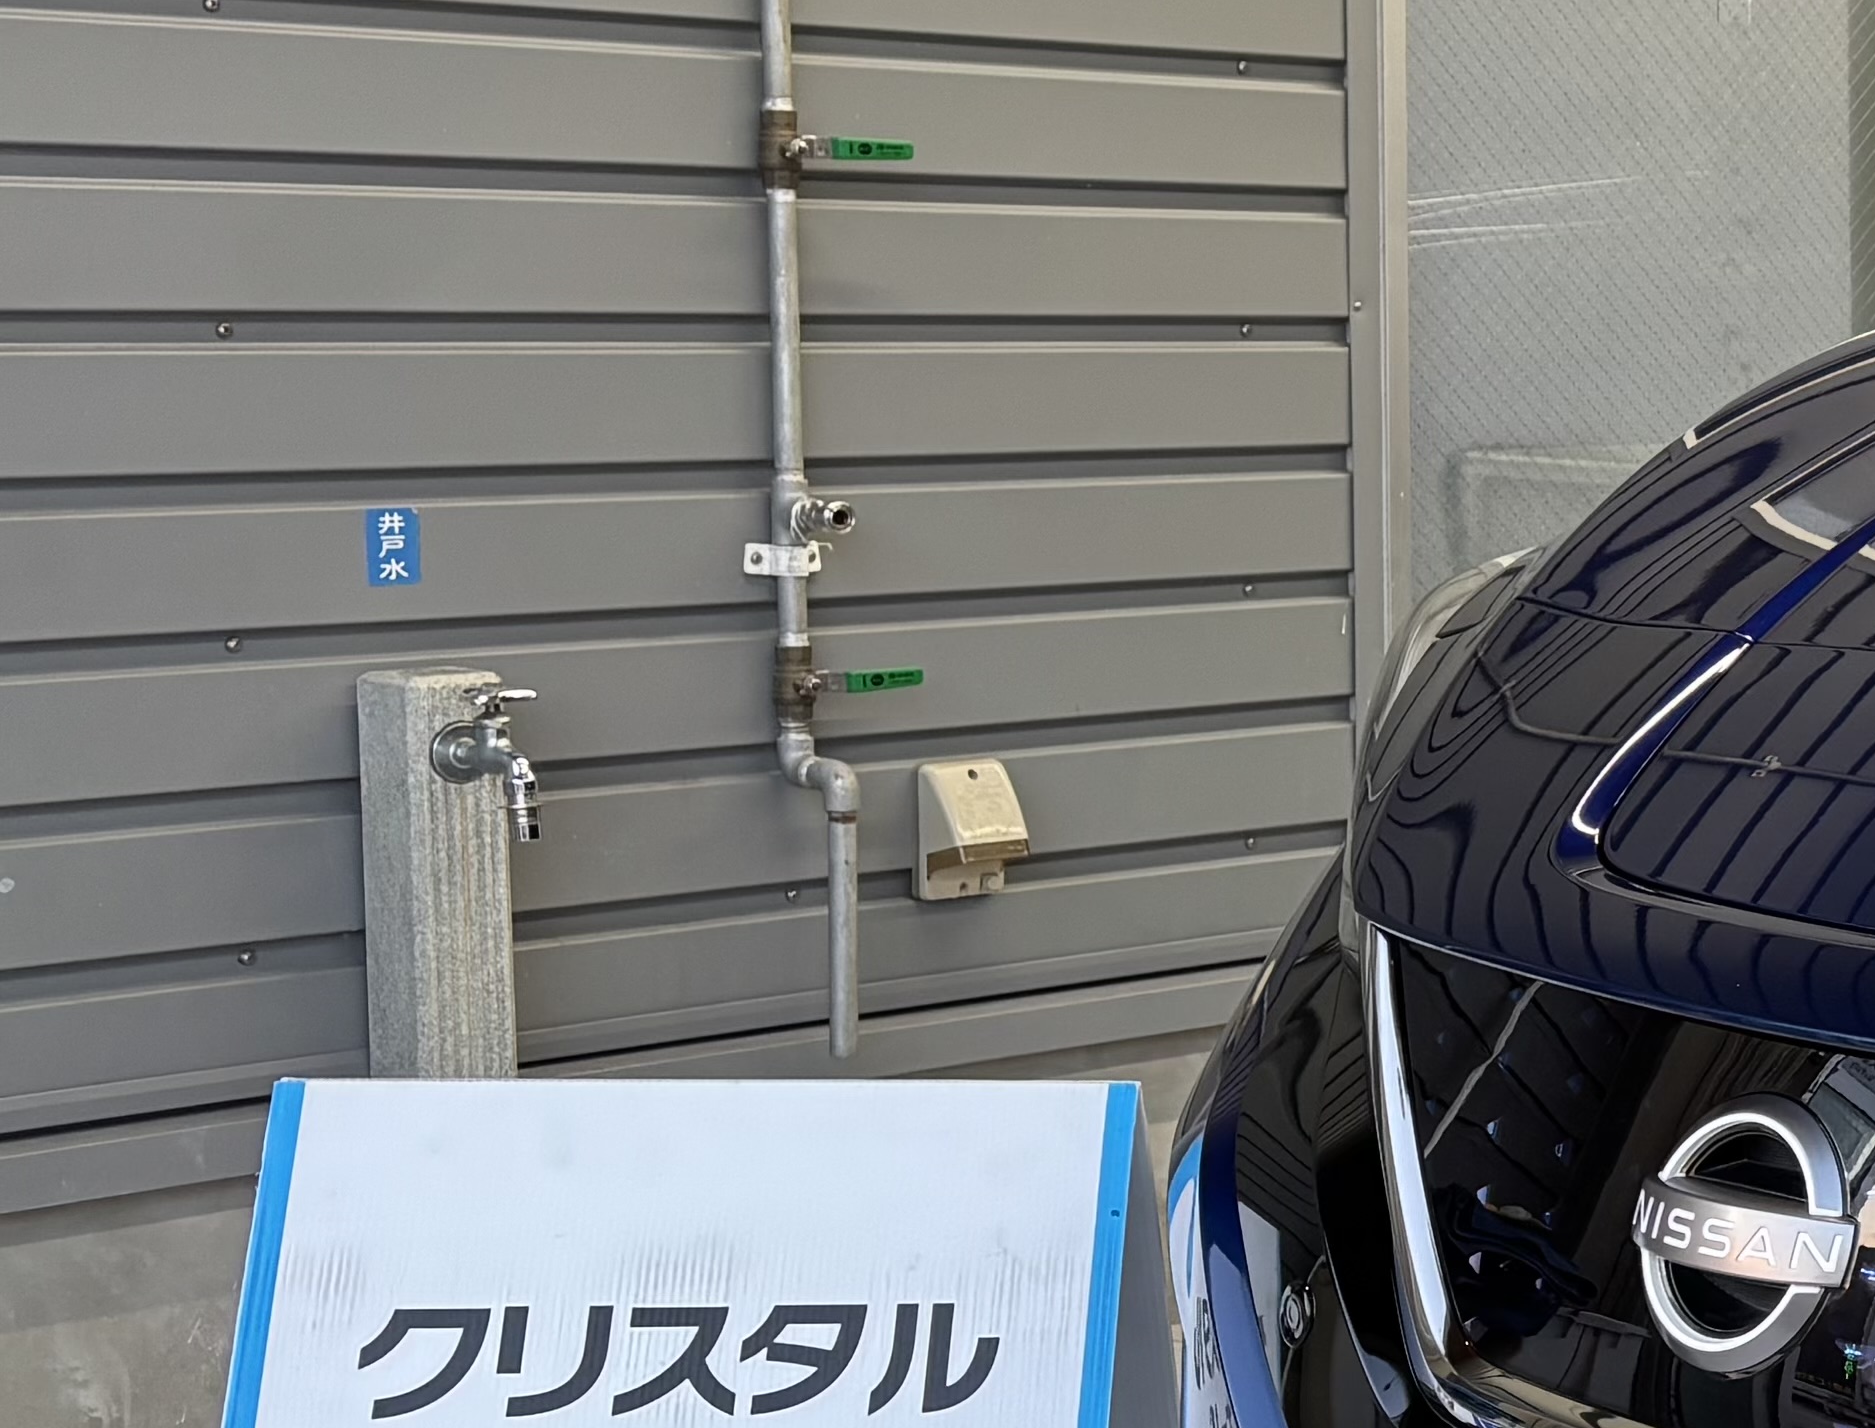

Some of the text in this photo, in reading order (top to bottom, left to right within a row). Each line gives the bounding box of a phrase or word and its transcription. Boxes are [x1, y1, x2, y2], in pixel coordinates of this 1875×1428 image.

[378, 512, 409, 581] 井戸水
[1632, 1186, 1845, 1275] NISSAN
[358, 1303, 1000, 1420] クリスタル
